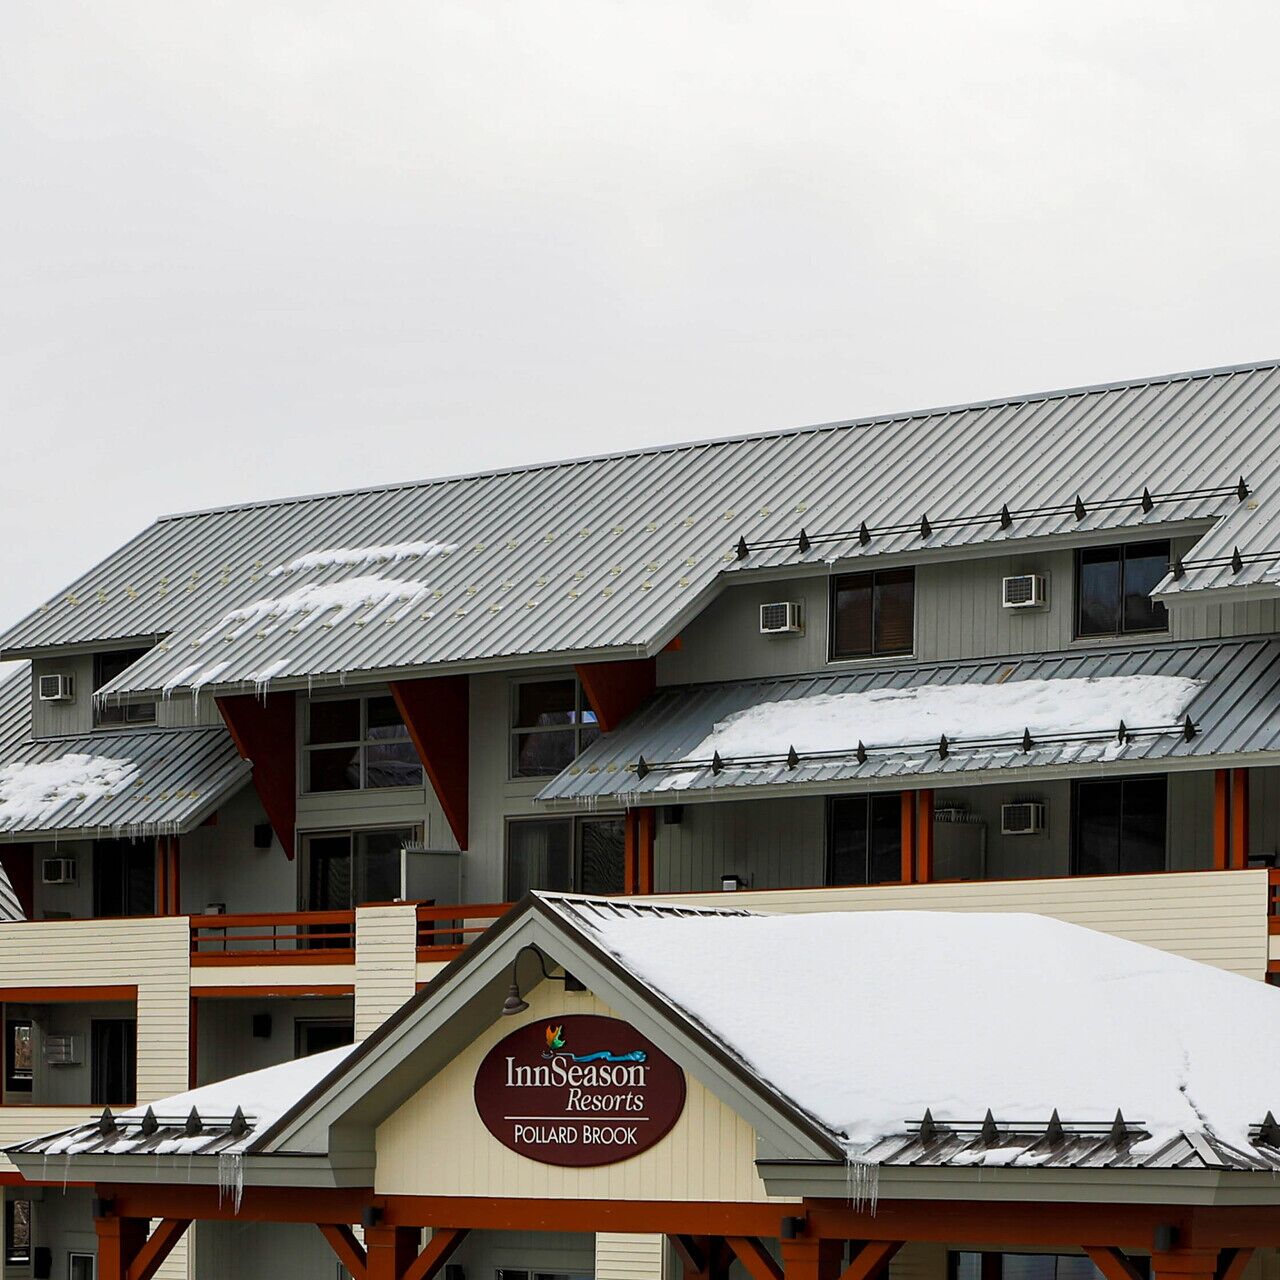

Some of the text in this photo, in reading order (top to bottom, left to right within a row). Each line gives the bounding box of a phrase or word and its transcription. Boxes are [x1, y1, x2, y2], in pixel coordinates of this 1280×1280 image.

[505, 1055, 647, 1087] InnSeason
[565, 1087, 644, 1111] Resorts
[514, 1124, 638, 1145] POLLARD BROOK
